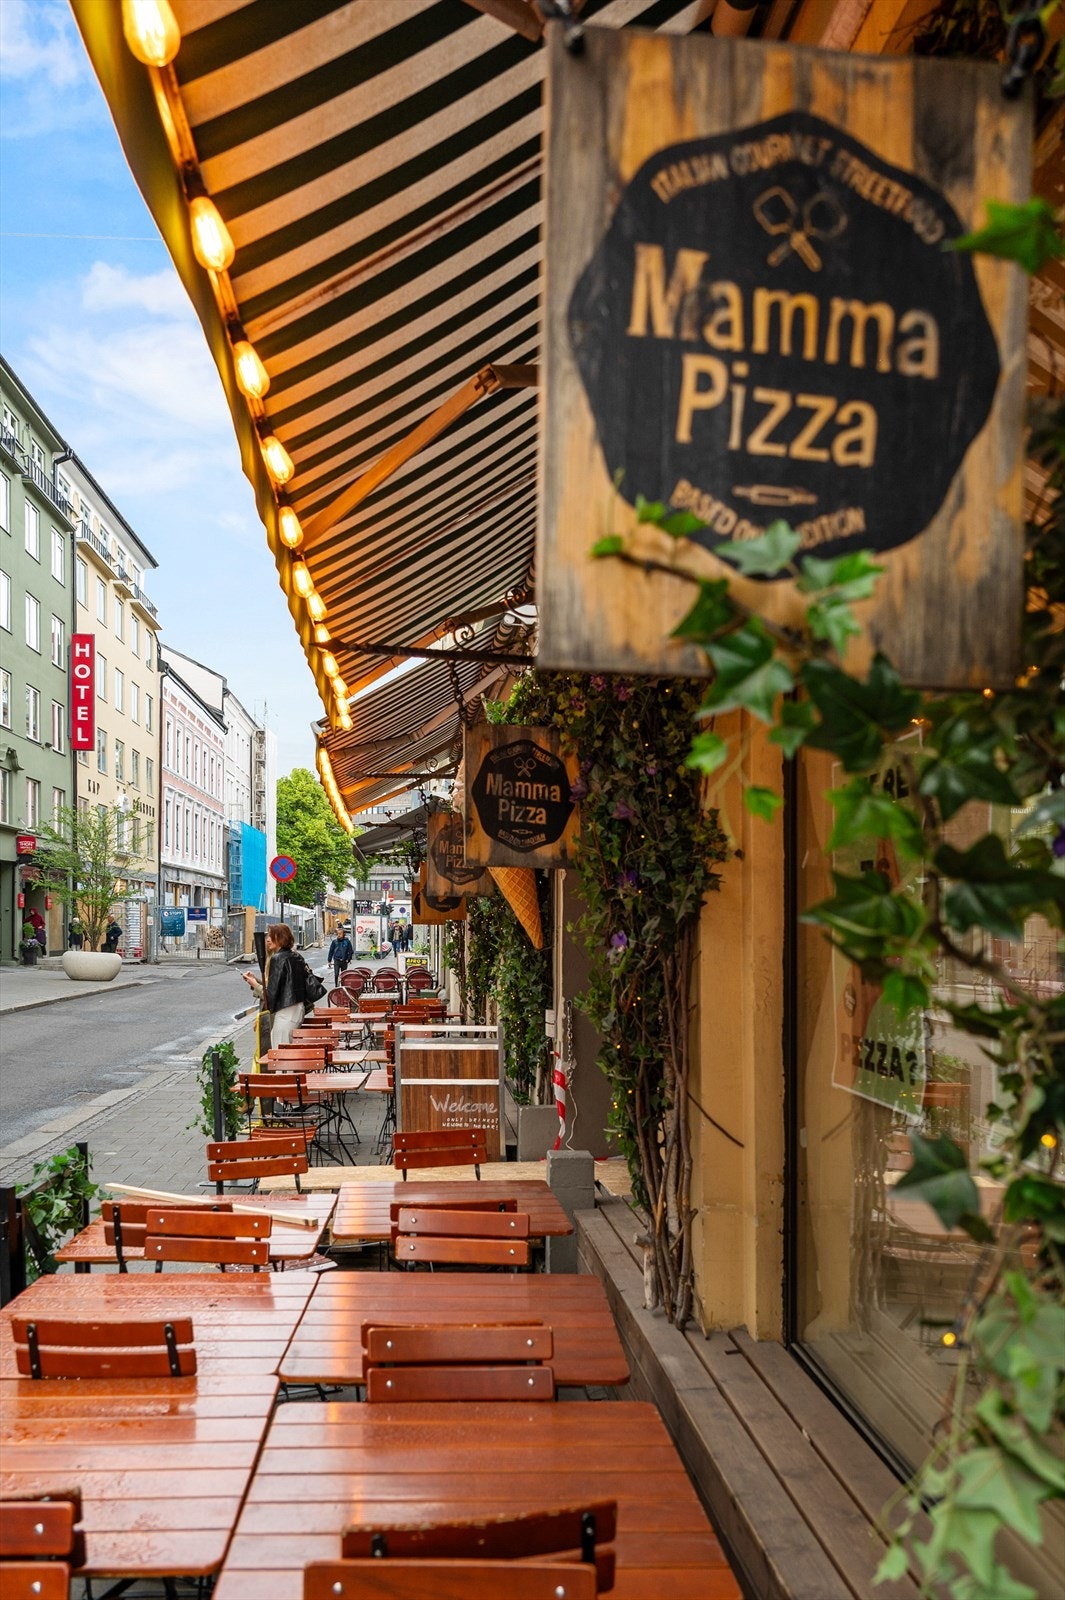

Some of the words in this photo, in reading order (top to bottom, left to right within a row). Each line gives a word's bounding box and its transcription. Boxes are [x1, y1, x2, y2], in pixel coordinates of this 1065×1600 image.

[626, 242, 940, 380] Mamma
[674, 353, 879, 468] Pizza
[74, 643, 91, 742] HOTEL
[486, 772, 561, 803] Mamma
[498, 799, 546, 825] Pizza
[439, 840, 465, 855] Mam
[430, 1093, 498, 1114] Welcome
